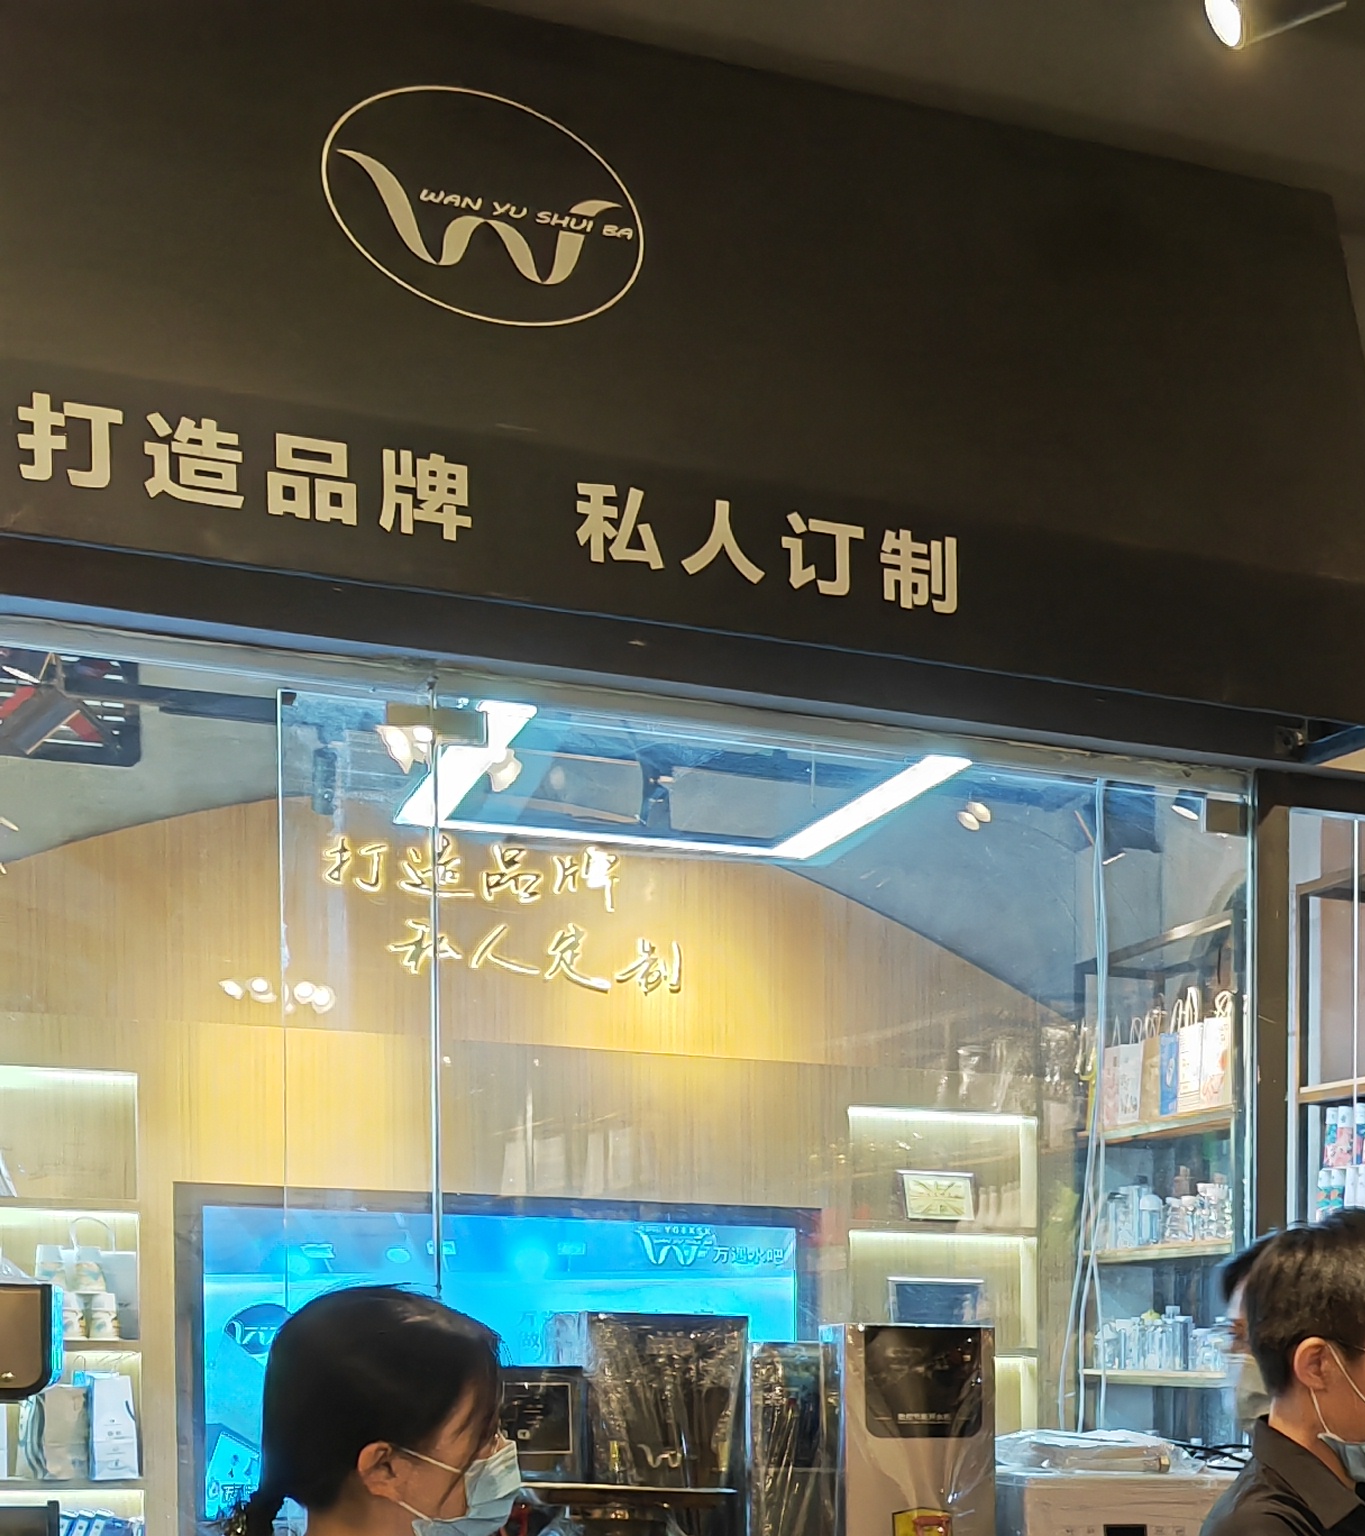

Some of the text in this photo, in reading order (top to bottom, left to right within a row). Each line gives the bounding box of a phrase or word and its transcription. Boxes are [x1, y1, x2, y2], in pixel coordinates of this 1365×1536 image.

[419, 188, 634, 240] WAN YU SHUI BA
[17, 393, 959, 614] 打造品牌 私人订制
[320, 838, 622, 912] 打造品牌
[389, 920, 683, 994] 私人定制
